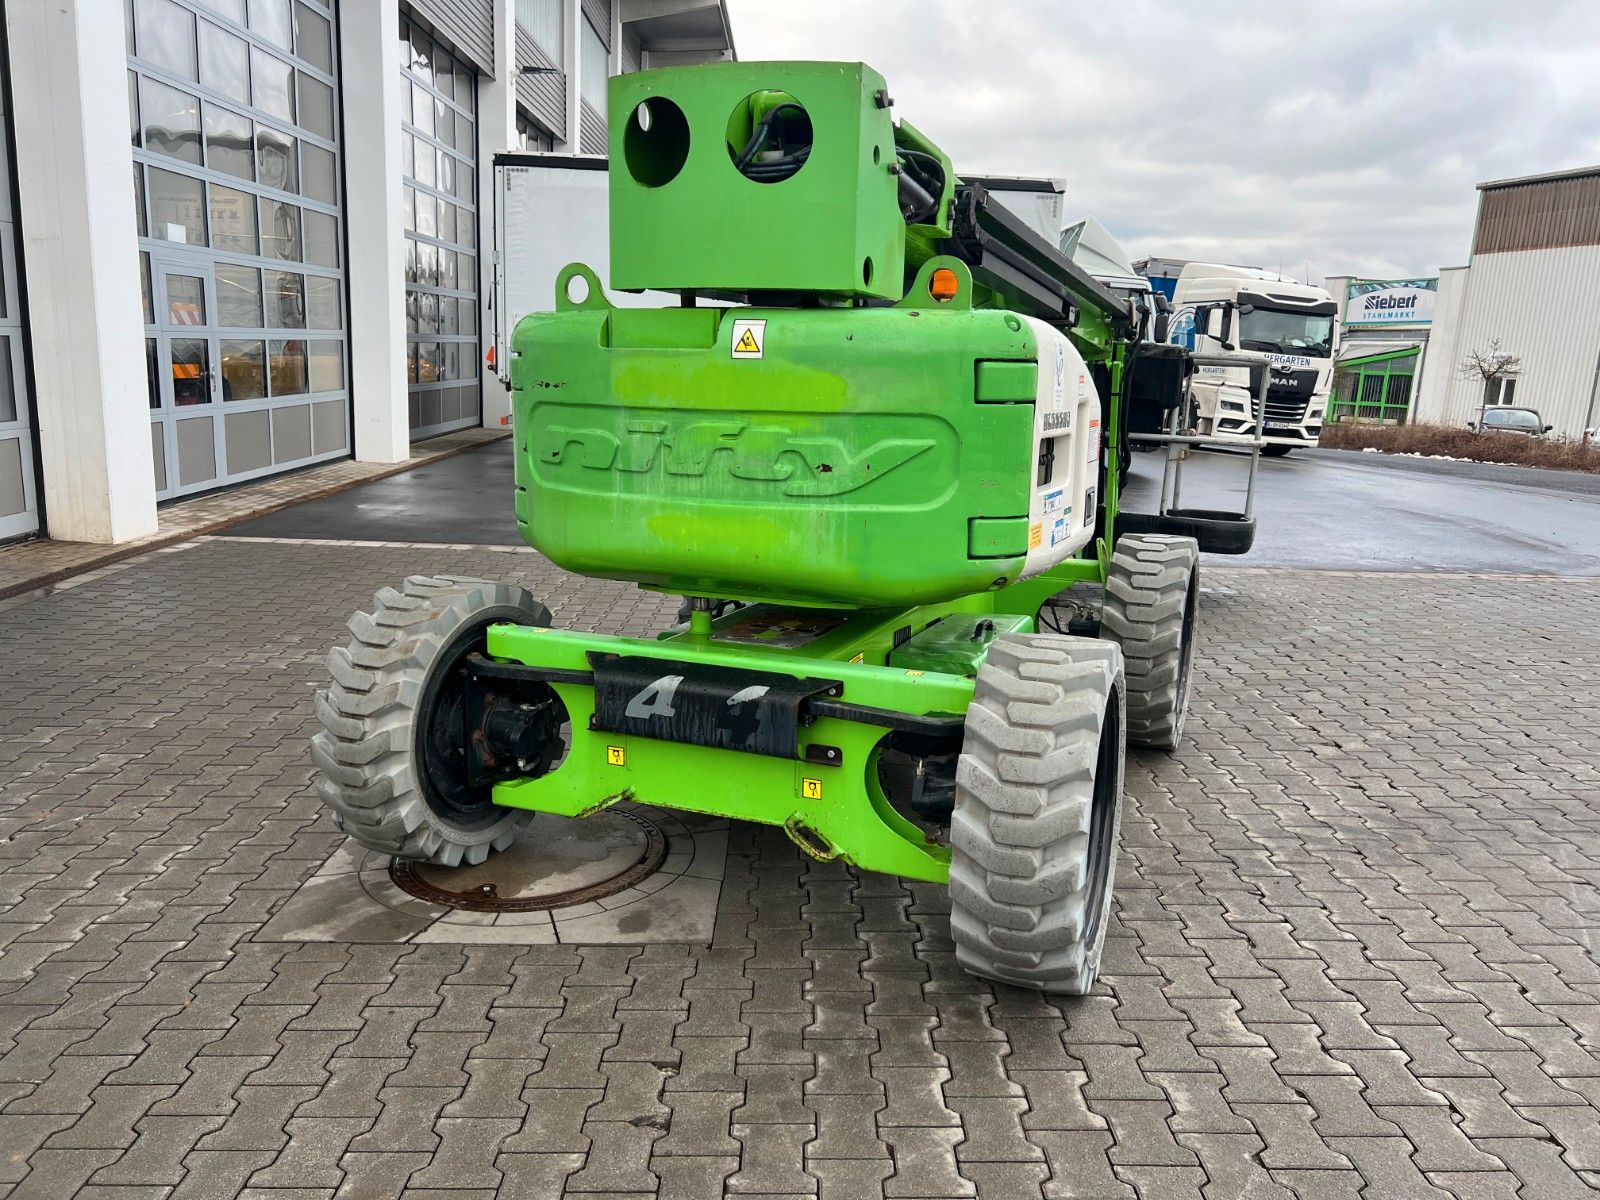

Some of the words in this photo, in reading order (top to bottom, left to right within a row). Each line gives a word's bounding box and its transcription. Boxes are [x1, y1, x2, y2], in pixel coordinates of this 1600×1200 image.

[1364, 293, 1417, 309] Siebert
[1363, 311, 1415, 319] STAHLMARKT
[1270, 377, 1298, 387] MAN
